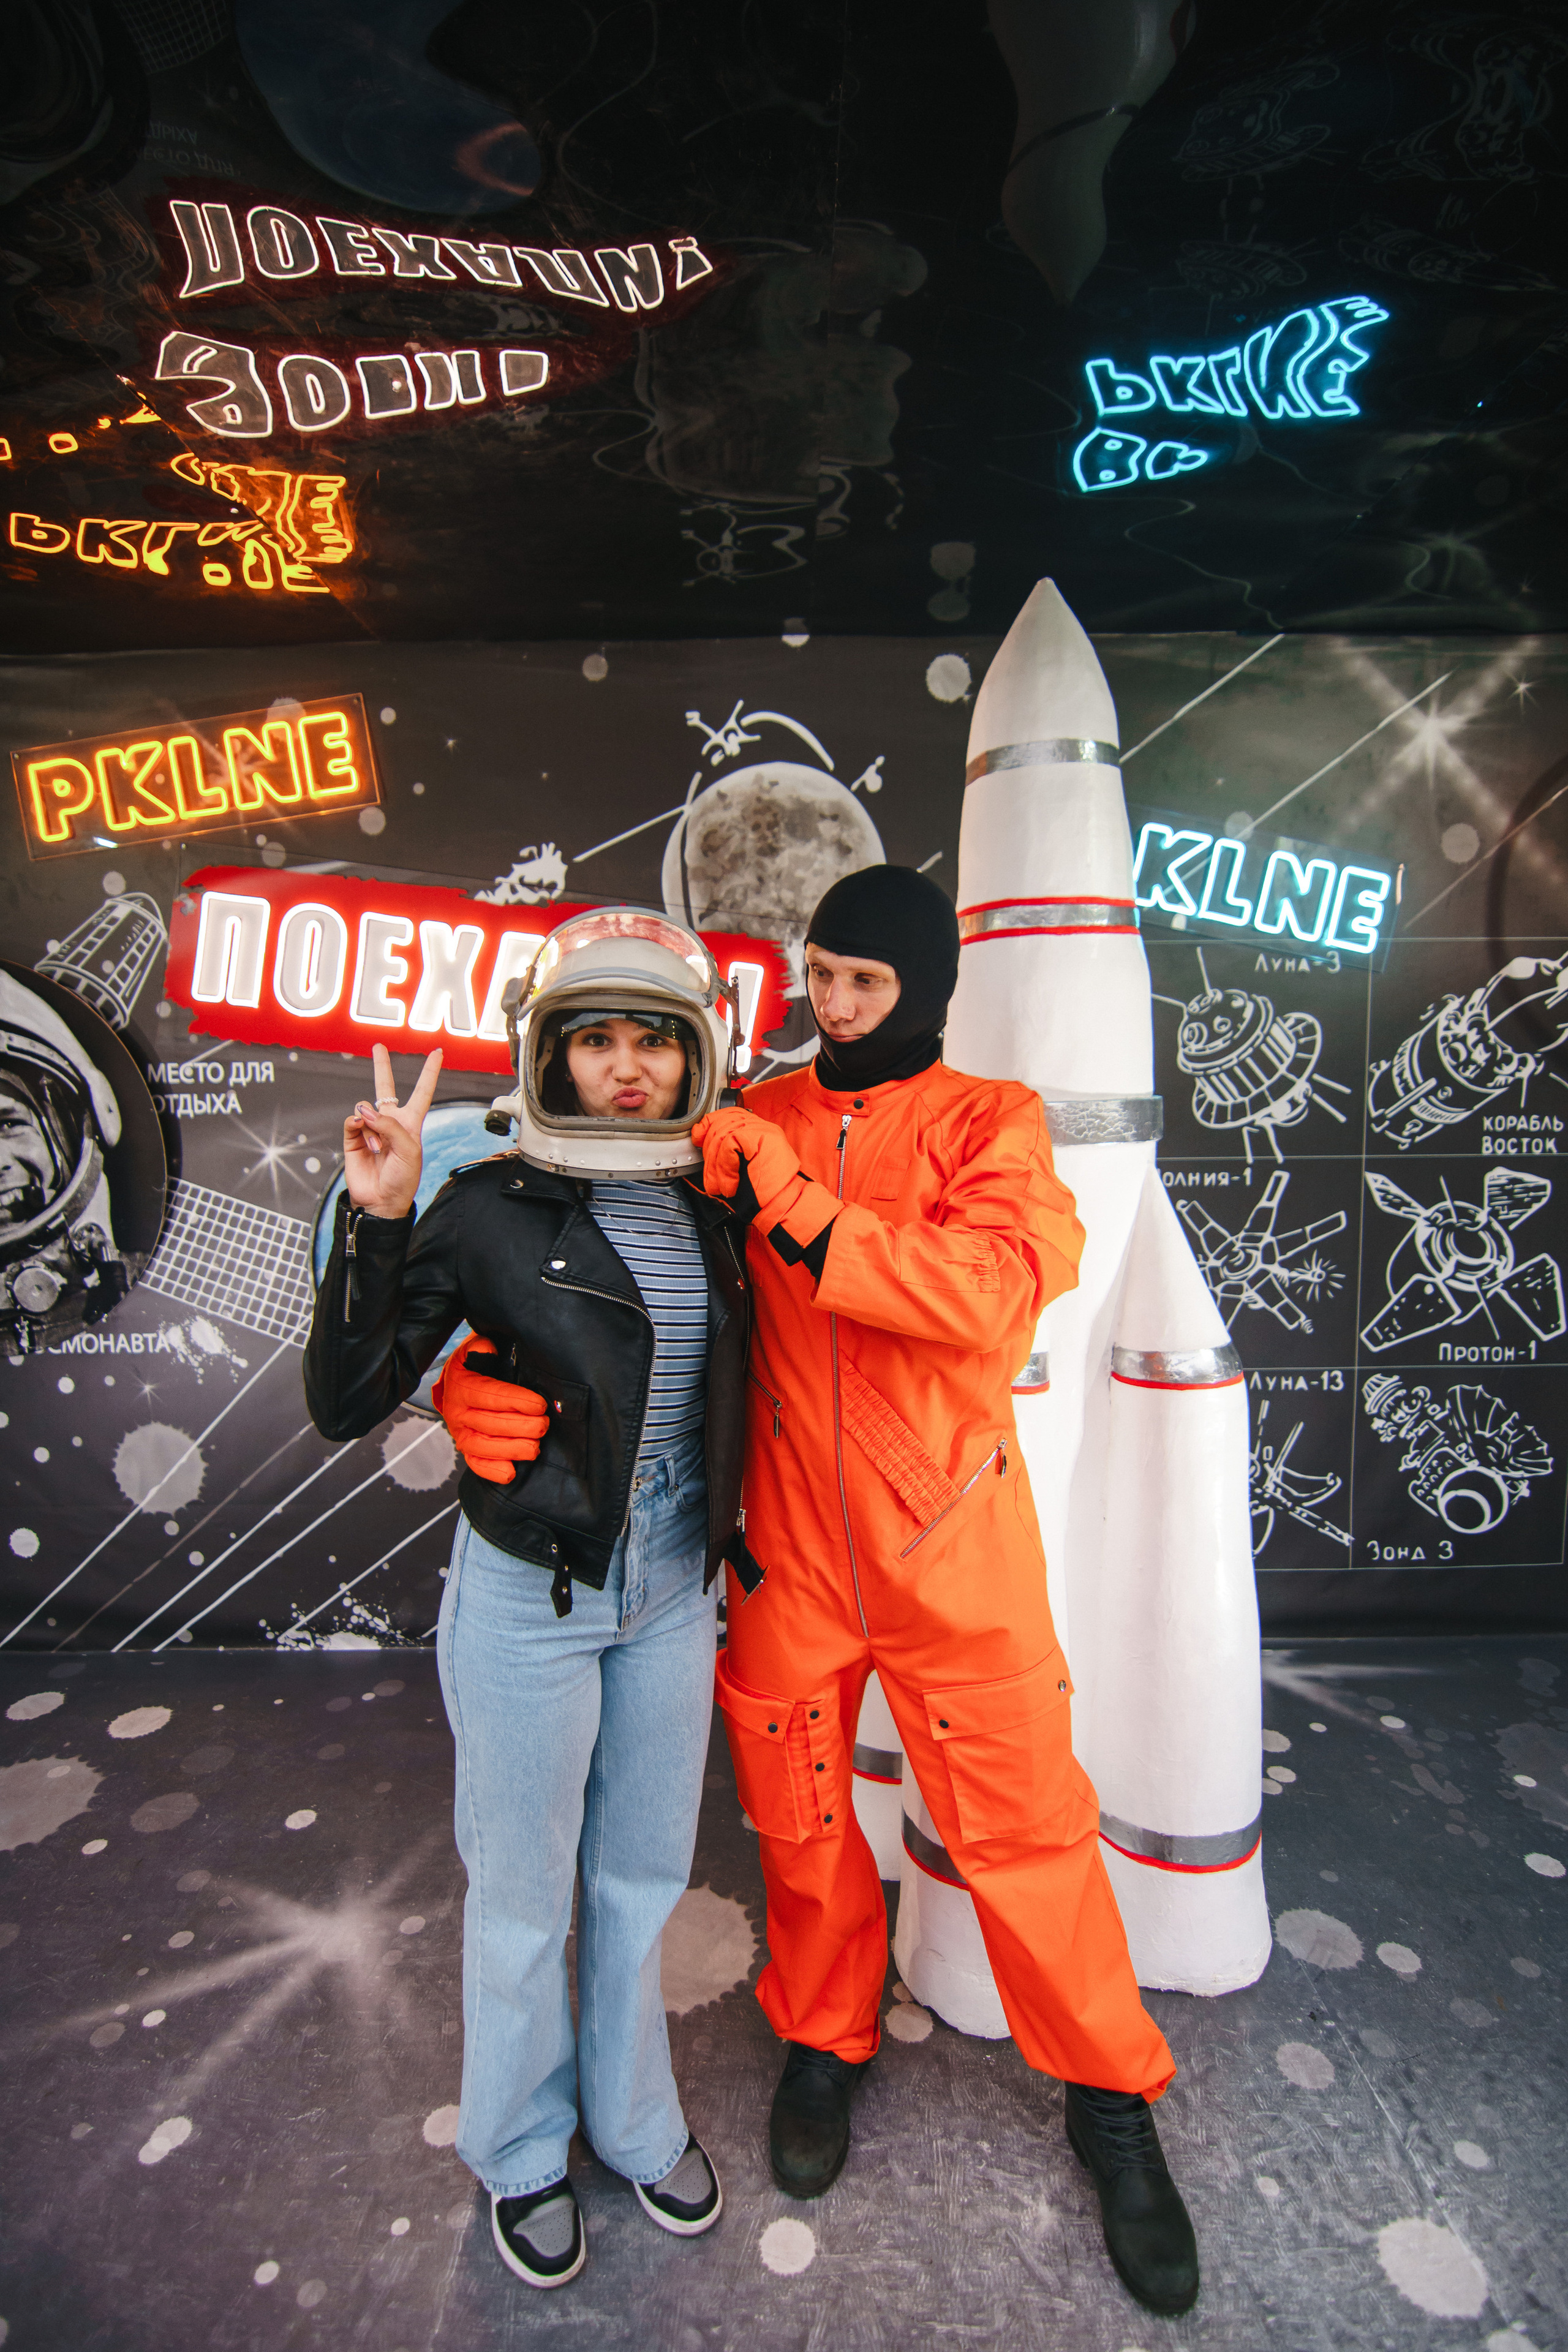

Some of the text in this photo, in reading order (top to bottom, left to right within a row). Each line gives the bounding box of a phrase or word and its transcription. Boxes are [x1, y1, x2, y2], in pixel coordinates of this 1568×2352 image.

[28, 710, 359, 843] PKLNE
[190, 891, 764, 1073] ПОЕХА!
[147, 1061, 275, 1087] МЕСТО ДЛЯ
[1483, 1115, 1564, 1132] КОРАБЛЬ
[1482, 1136, 1558, 1154] ВОСТОК
[1157, 1167, 1253, 1188] ОЛНИЯ-1
[35, 1332, 172, 1354] МОНАВТА
[1438, 1340, 1537, 1362] ПРОТОН-1
[1249, 1370, 1346, 1392] ЛУНА-13
[1366, 1540, 1454, 1561] ЗОНД 3
